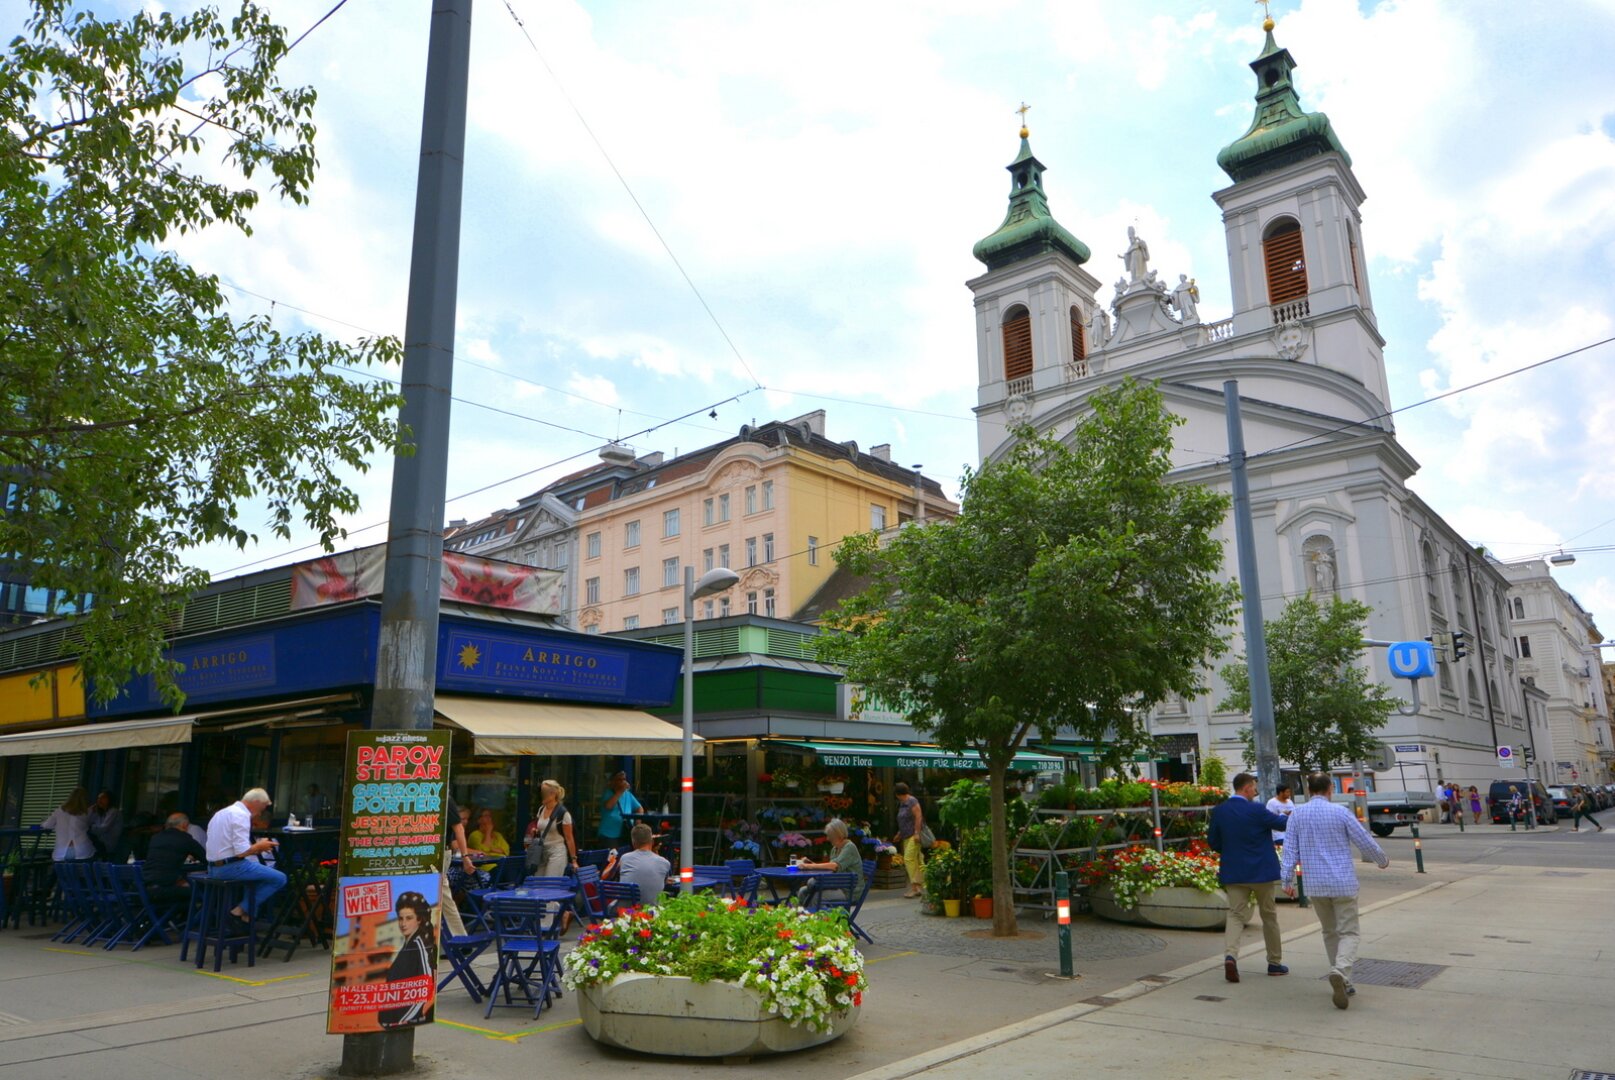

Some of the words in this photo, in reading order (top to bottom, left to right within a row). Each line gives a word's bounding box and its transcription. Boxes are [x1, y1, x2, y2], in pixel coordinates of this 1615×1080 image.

[192, 650, 247, 670] ARRIGO
[523, 647, 597, 668] ARRIGO
[1394, 648, 1419, 672] U
[357, 746, 444, 765] PAROV
[852, 755, 873, 767] Flora
[933, 758, 949, 768] FÜR
[953, 760, 973, 769] HERZ
[976, 760, 988, 769] UN
[356, 764, 442, 780] STELAR
[352, 782, 443, 798] GREGORY
[352, 796, 441, 814] PORTER
[351, 814, 440, 829] JESTOFUNK
[348, 837, 372, 848] THE
[373, 836, 398, 847] CAT
[398, 834, 440, 846] EMPIRE
[352, 847, 391, 858] FREAK
[393, 845, 435, 857] POWER
[346, 887, 360, 898] WIR
[363, 885, 378, 896] SIND
[347, 895, 379, 913] WIEN
[351, 984, 377, 993] ALLEN
[379, 983, 389, 991] 23
[390, 979, 429, 990] BEZIRKEN
[340, 993, 370, 1005] 1.-23.
[371, 991, 400, 1004] JUNI
[403, 987, 428, 1000] 2018
